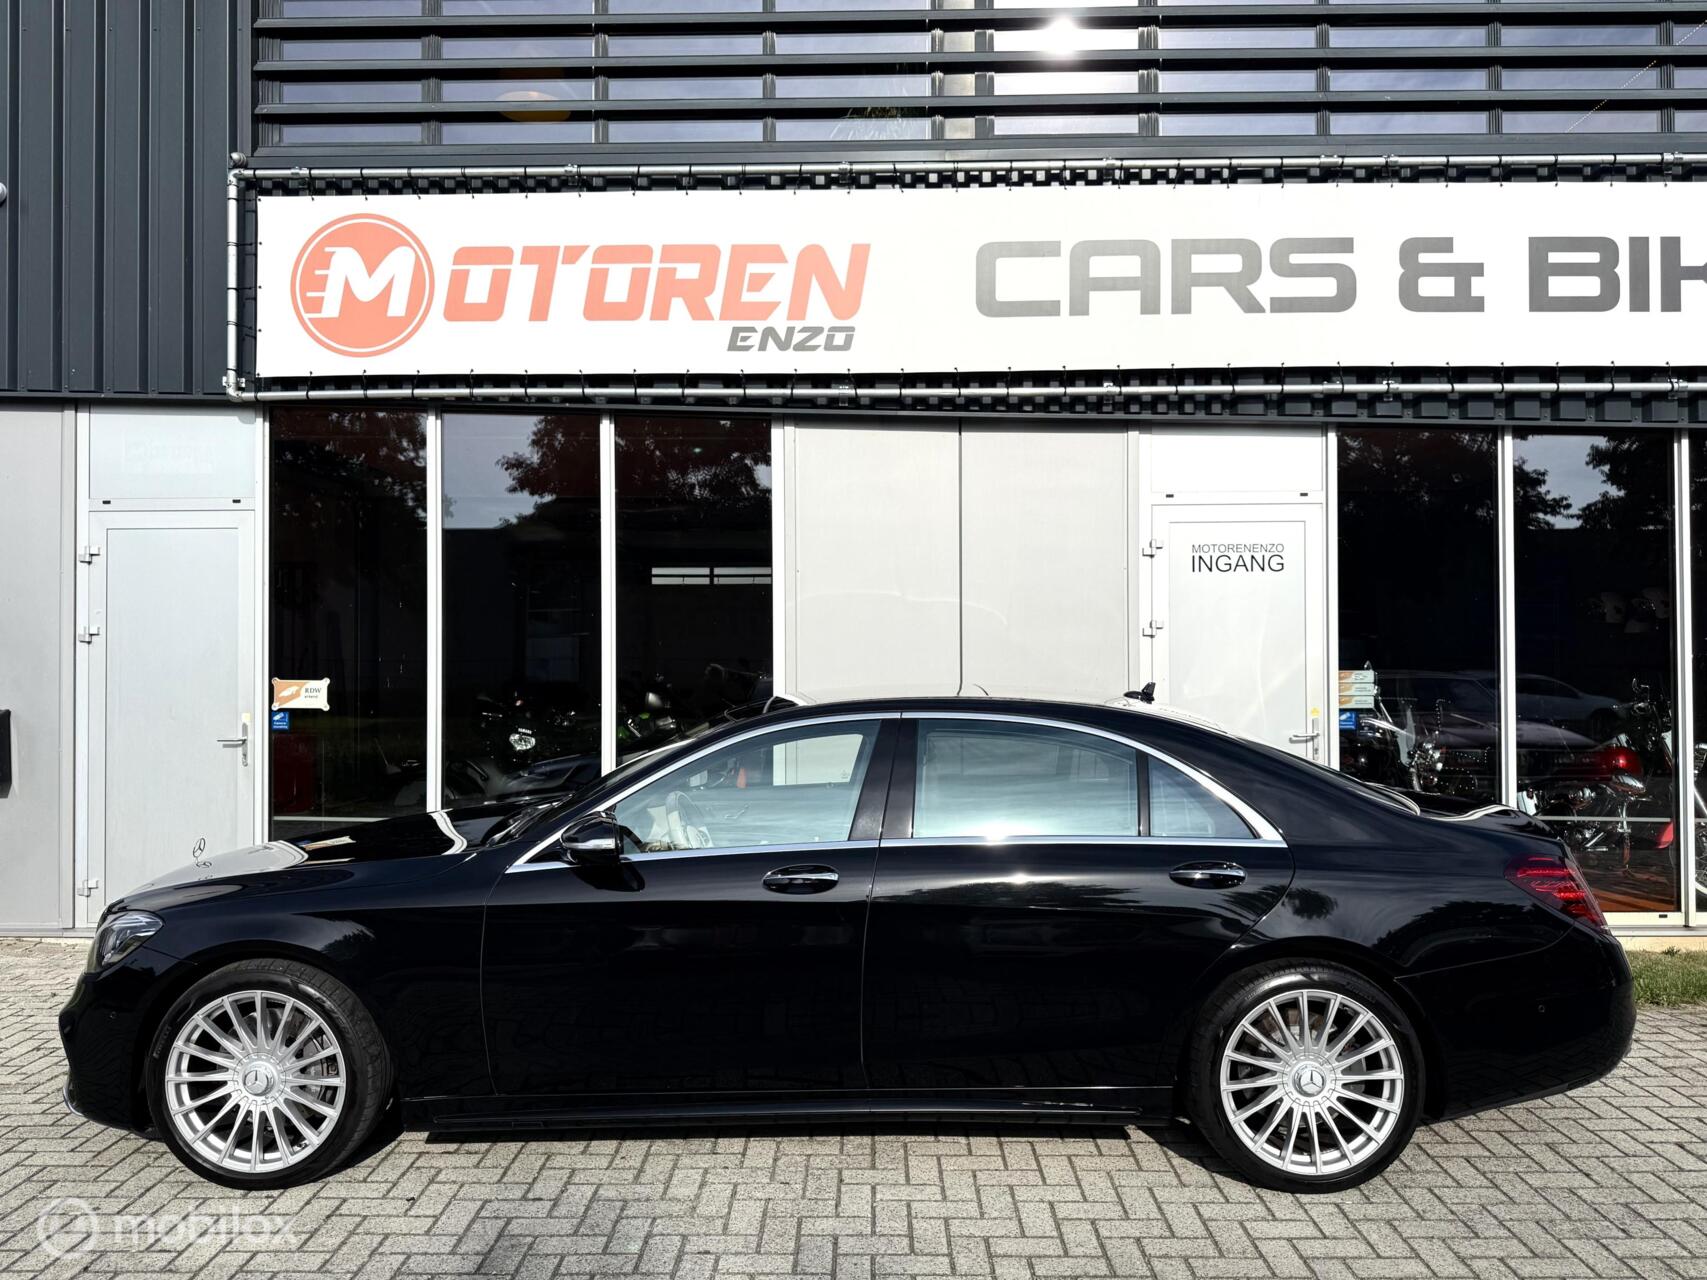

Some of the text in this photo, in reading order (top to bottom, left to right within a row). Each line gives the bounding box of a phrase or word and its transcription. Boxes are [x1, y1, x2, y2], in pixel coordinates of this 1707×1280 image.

[975, 236, 1358, 318] CARS
[1398, 236, 1486, 313] &
[726, 326, 857, 352] ENZO
[1191, 543, 1285, 554] MOTORENENZO
[1191, 554, 1285, 573] INGANG
